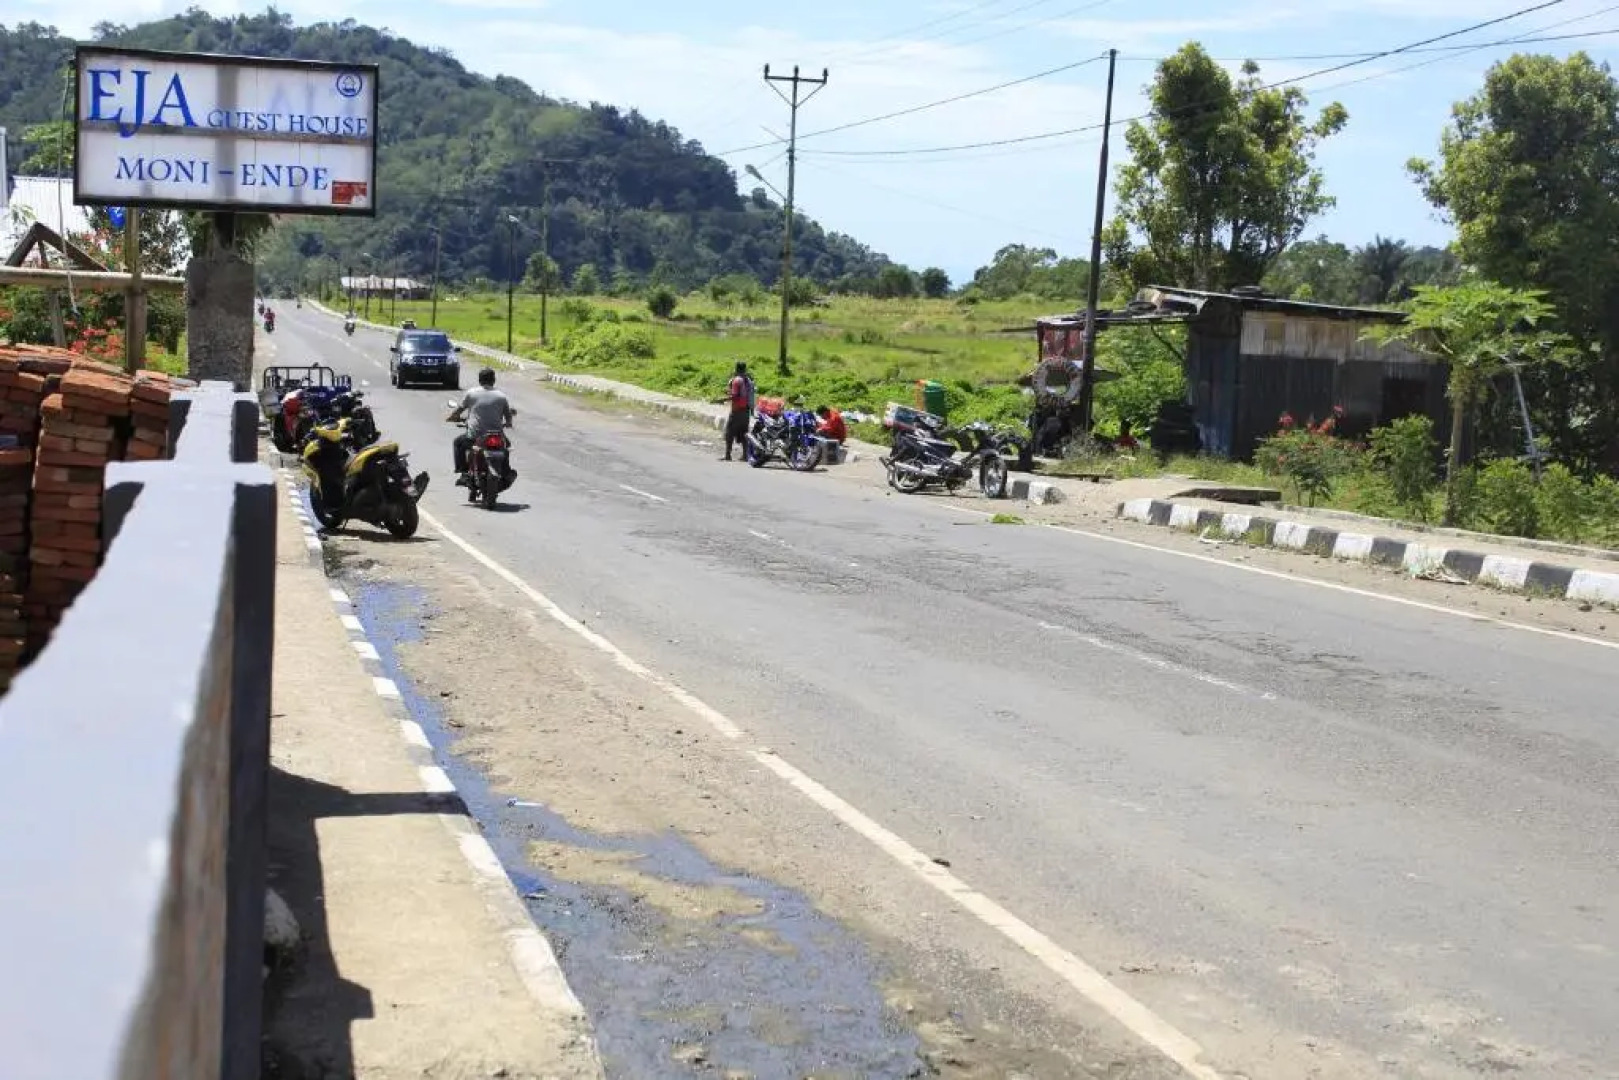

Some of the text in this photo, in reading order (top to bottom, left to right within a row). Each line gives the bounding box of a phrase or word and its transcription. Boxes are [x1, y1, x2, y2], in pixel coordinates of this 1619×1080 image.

[87, 69, 368, 138] EJA GUEST HOUSE
[115, 157, 209, 184] MONI
[241, 164, 328, 190] ENDE
